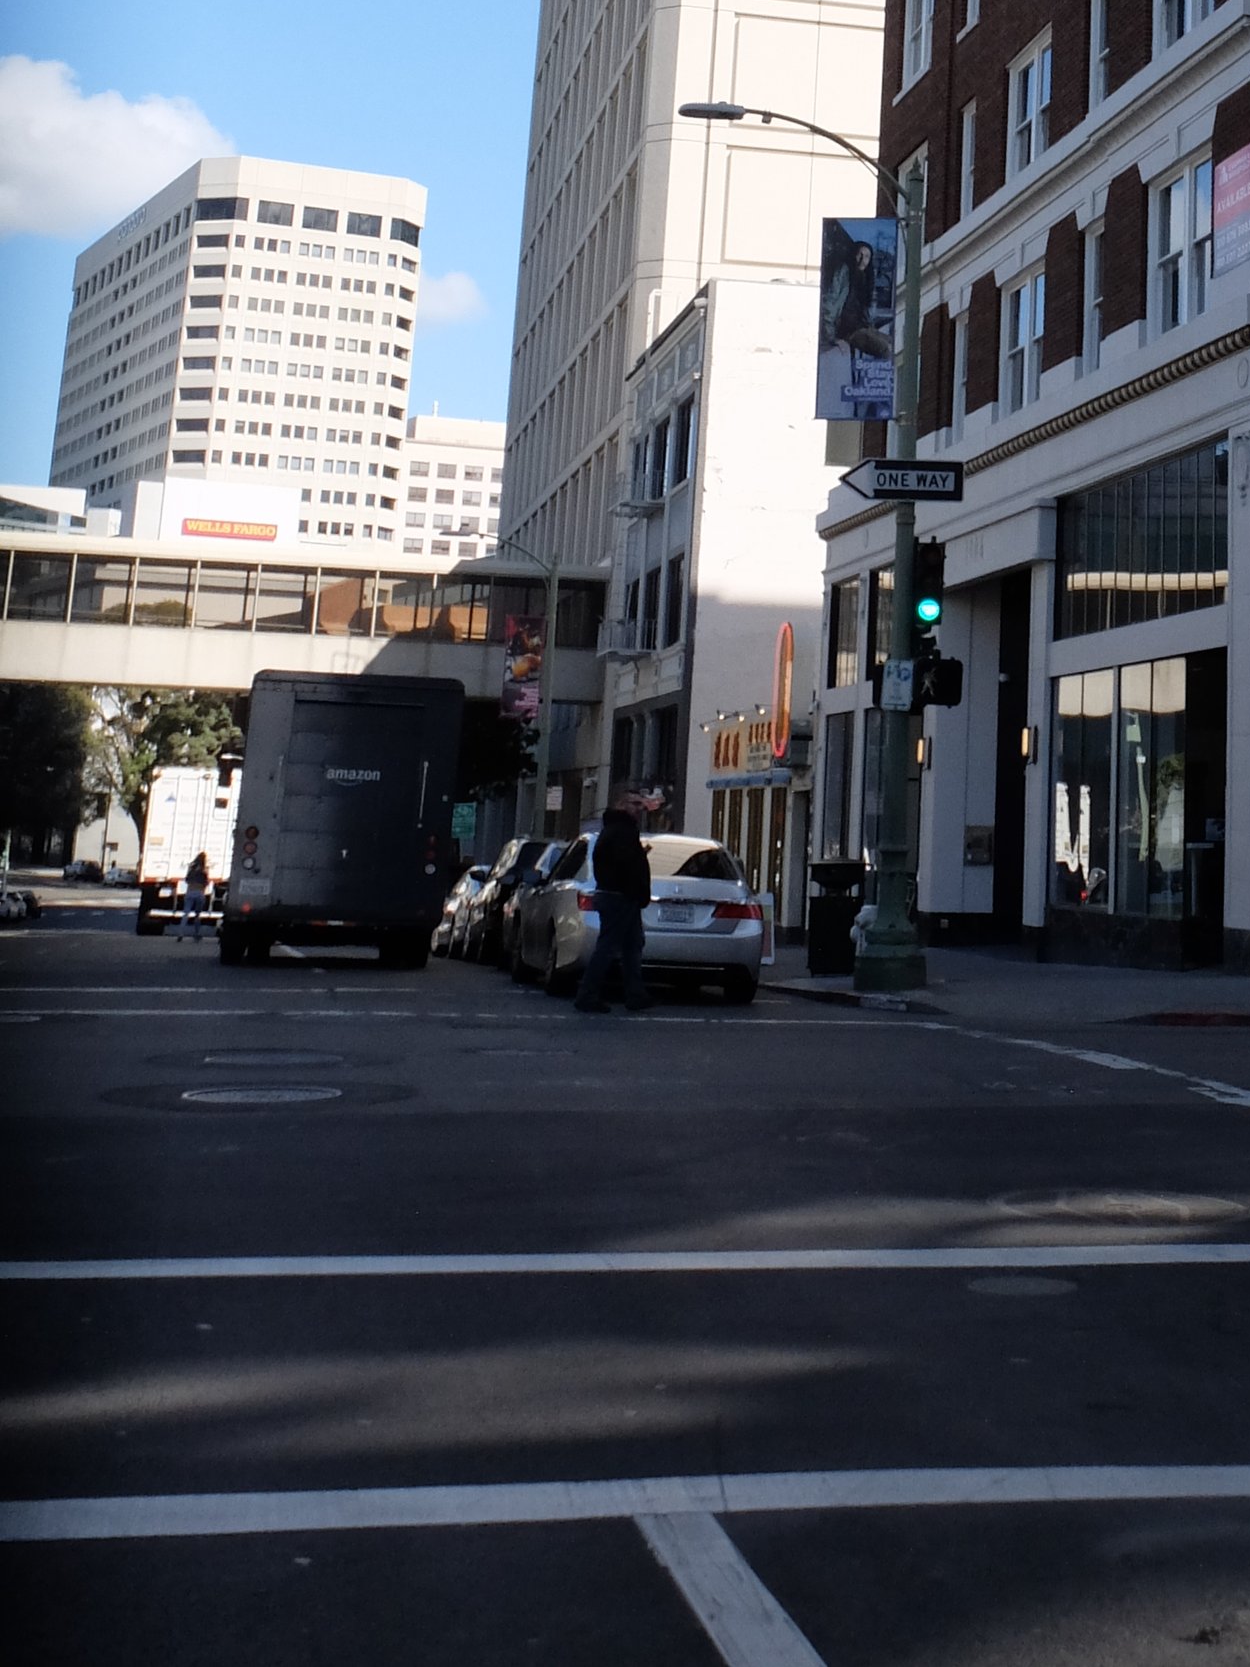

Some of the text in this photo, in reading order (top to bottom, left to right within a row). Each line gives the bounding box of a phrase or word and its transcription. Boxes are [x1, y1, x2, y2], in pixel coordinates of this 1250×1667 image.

[877, 473, 949, 488] ONE WAY
[187, 520, 276, 537] WELLS FARGO
[326, 768, 381, 781] amazon
